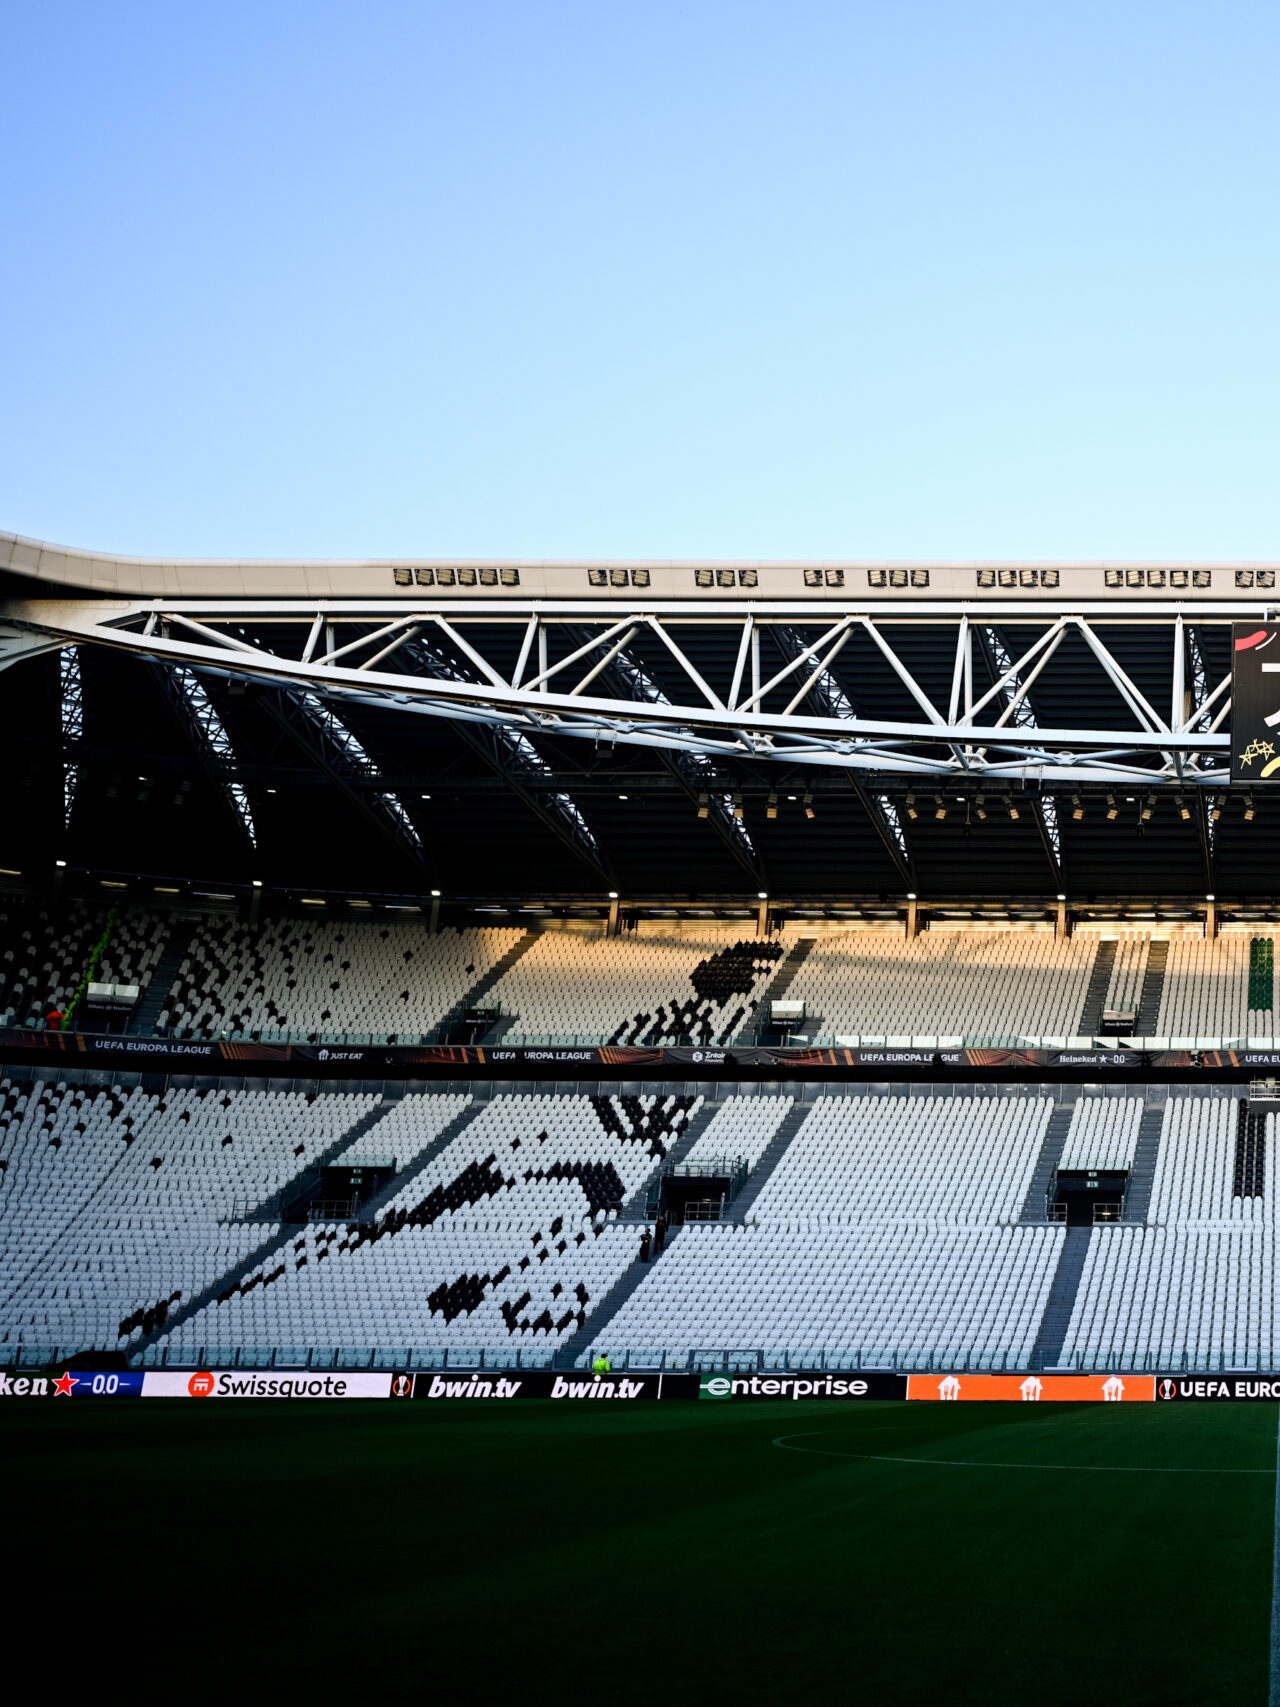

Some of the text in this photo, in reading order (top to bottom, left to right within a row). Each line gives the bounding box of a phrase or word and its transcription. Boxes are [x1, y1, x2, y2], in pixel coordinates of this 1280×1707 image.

[95, 1040, 211, 1055] UEFA EUROPA LEAGUE
[330, 1052, 349, 1060] JUST
[524, 1052, 554, 1060] UROPA
[556, 1052, 592, 1060] LEAGUE
[860, 1053, 959, 1062] UEFA EUROPA LEGUE
[1059, 1055, 1097, 1063] Heineken
[1245, 1055, 1270, 1063] UEFA
[217, 1373, 347, 1398] Swissquote
[428, 1374, 522, 1398] bwin.tv
[550, 1374, 645, 1399] bwin.tv
[699, 1375, 868, 1400] enterprise
[1180, 1381, 1231, 1397] UEFA
